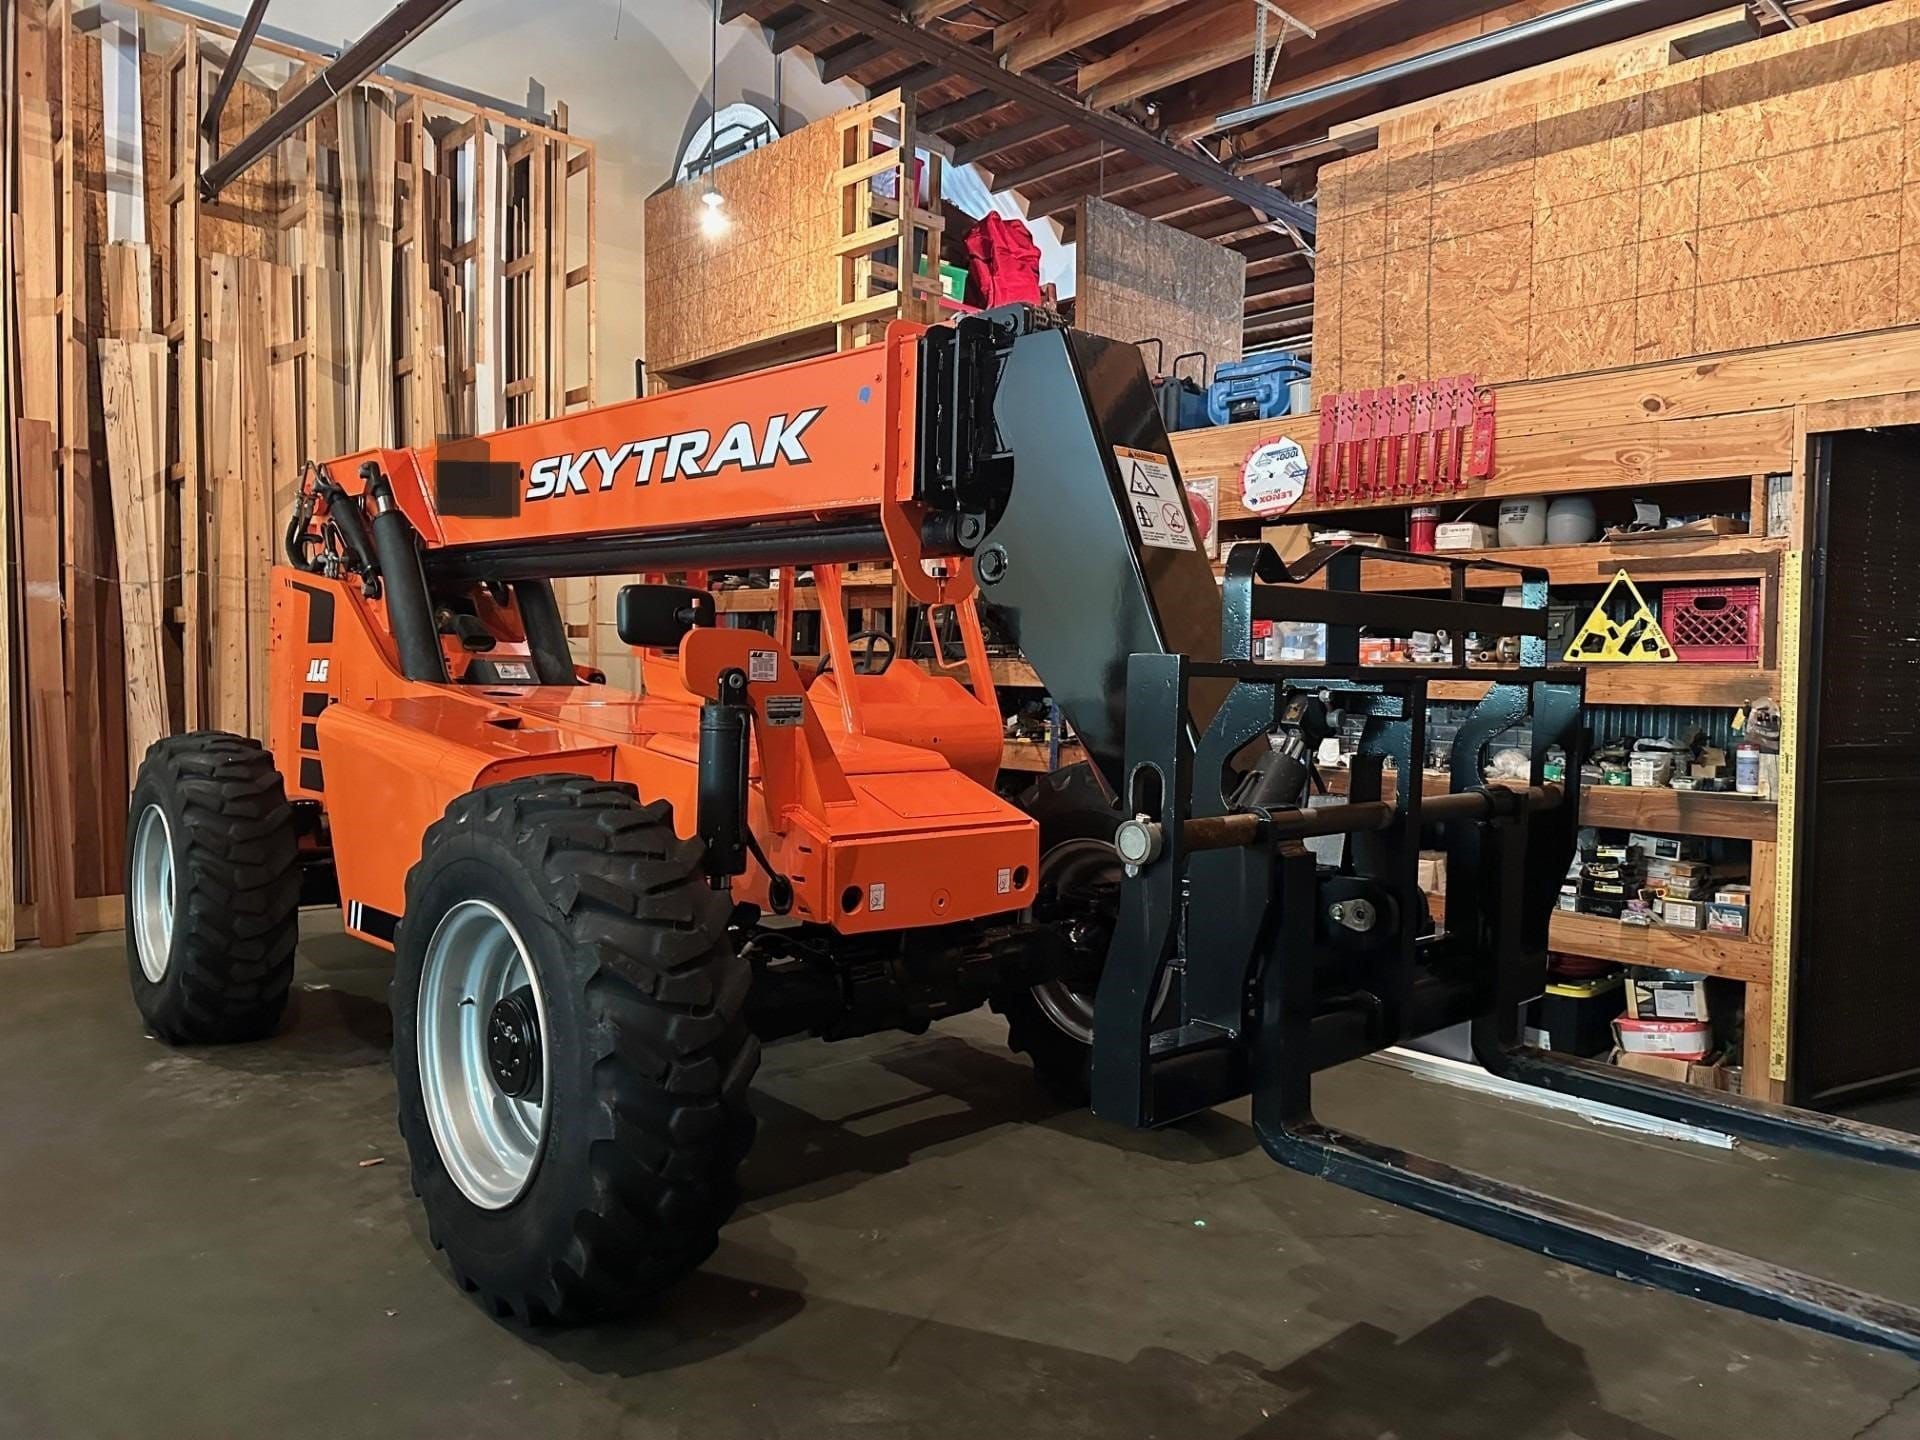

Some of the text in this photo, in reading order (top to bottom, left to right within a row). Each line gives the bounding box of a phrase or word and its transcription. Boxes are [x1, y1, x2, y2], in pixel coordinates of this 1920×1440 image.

[525, 405, 828, 502] SKYTRAK
[1258, 490, 1293, 505] LENOX
[305, 657, 329, 683] JLG
